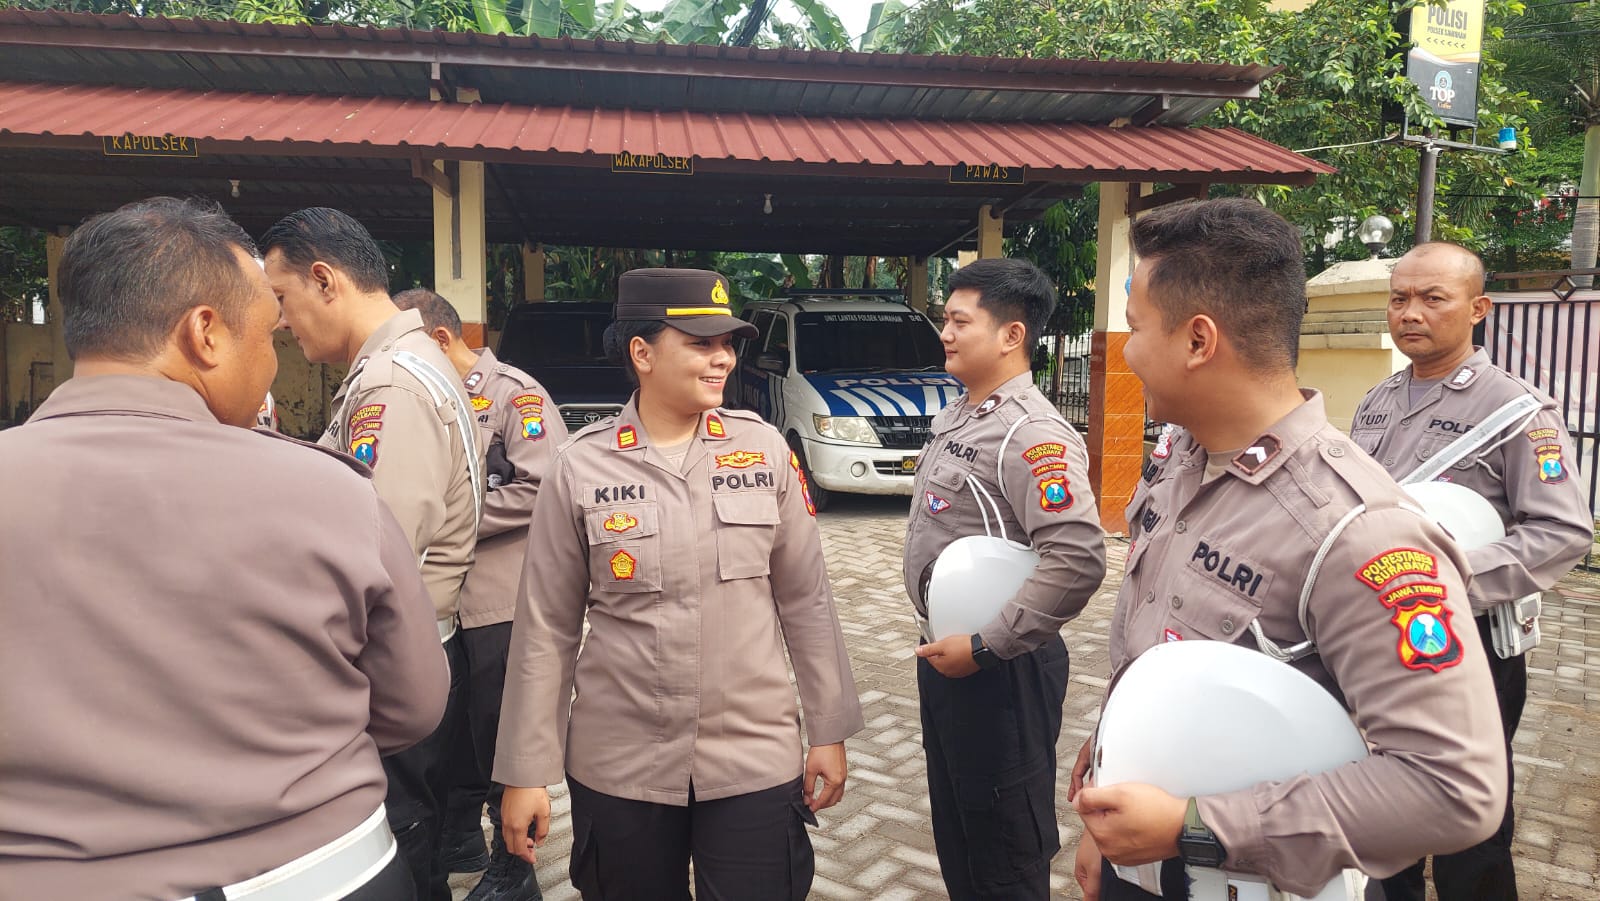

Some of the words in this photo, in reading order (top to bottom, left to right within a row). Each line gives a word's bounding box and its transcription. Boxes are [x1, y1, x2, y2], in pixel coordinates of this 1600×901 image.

[1427, 4, 1468, 31] POLISI
[1429, 86, 1456, 103] TOP
[112, 134, 189, 152] KAPOLSEK
[615, 153, 690, 170] WAKAPOLSEK
[965, 164, 1009, 180] PAWAS
[835, 377, 960, 388] POLISI
[1360, 414, 1388, 425] YUDI
[1429, 419, 1475, 434] POL
[943, 440, 979, 463] POLRI
[712, 471, 774, 491] POLRI
[595, 484, 646, 504] KIKI
[1191, 541, 1263, 598] POLRI
[1362, 551, 1434, 581] POLRESTABES
[1374, 560, 1432, 585] SURABAYA
[1387, 586, 1414, 603] JAWA
[1414, 584, 1443, 596] TIMUR
